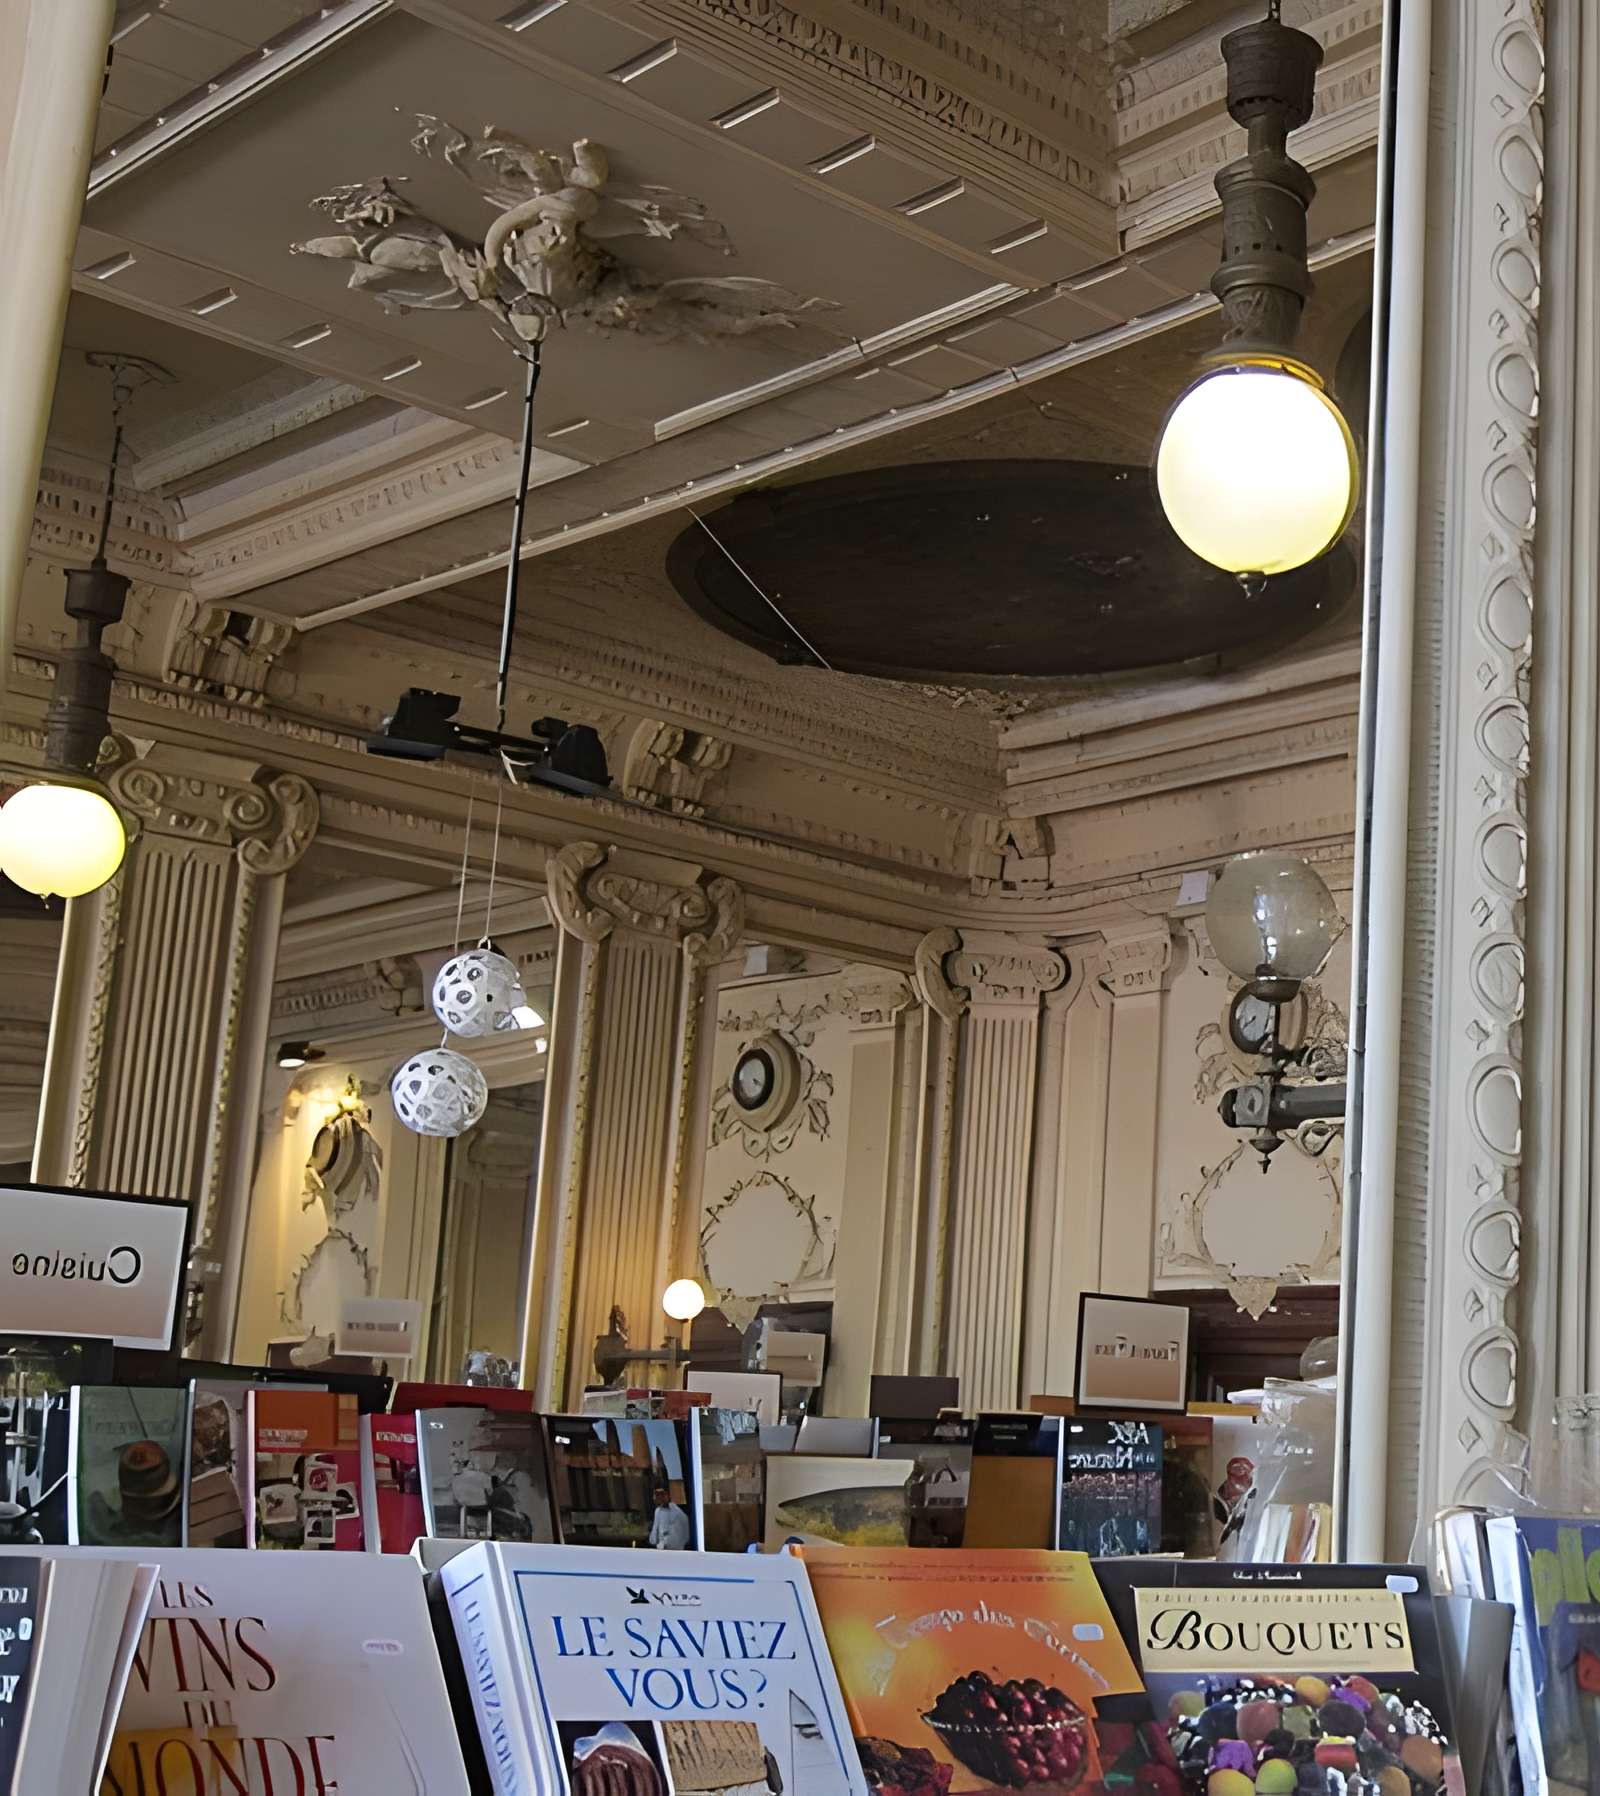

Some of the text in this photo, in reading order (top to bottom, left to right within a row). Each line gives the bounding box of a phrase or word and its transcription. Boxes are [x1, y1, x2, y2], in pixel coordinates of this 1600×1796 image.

[132, 1616, 277, 1692] VINS
[551, 1615, 797, 1660] LE SAVIEZ
[1146, 1608, 1405, 1656] BOUQUETS
[605, 1667, 768, 1711] VOUS?
